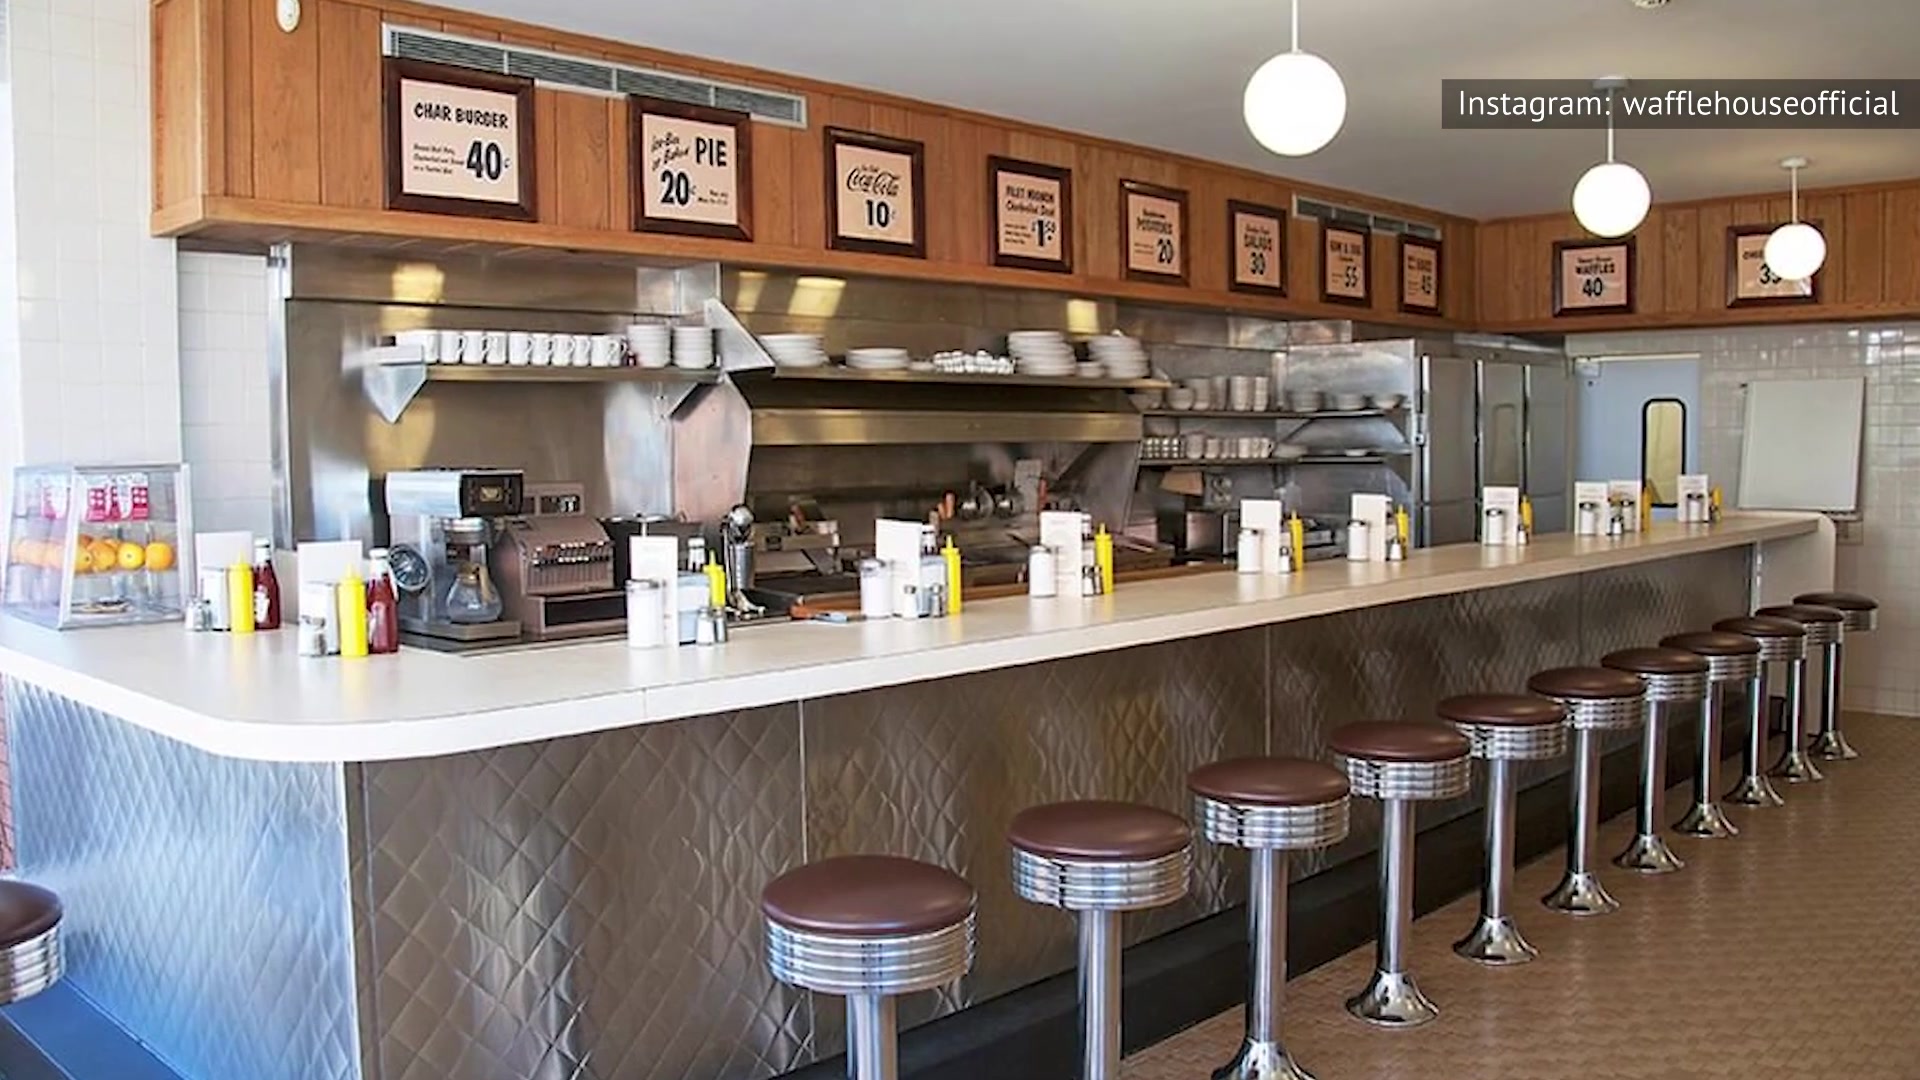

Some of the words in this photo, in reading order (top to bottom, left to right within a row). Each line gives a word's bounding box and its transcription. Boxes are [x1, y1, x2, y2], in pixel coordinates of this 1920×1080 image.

[414, 102, 451, 122] CHAR
[455, 108, 508, 129] BURGER
[695, 136, 727, 167] PIE
[1582, 277, 1603, 297] 40
